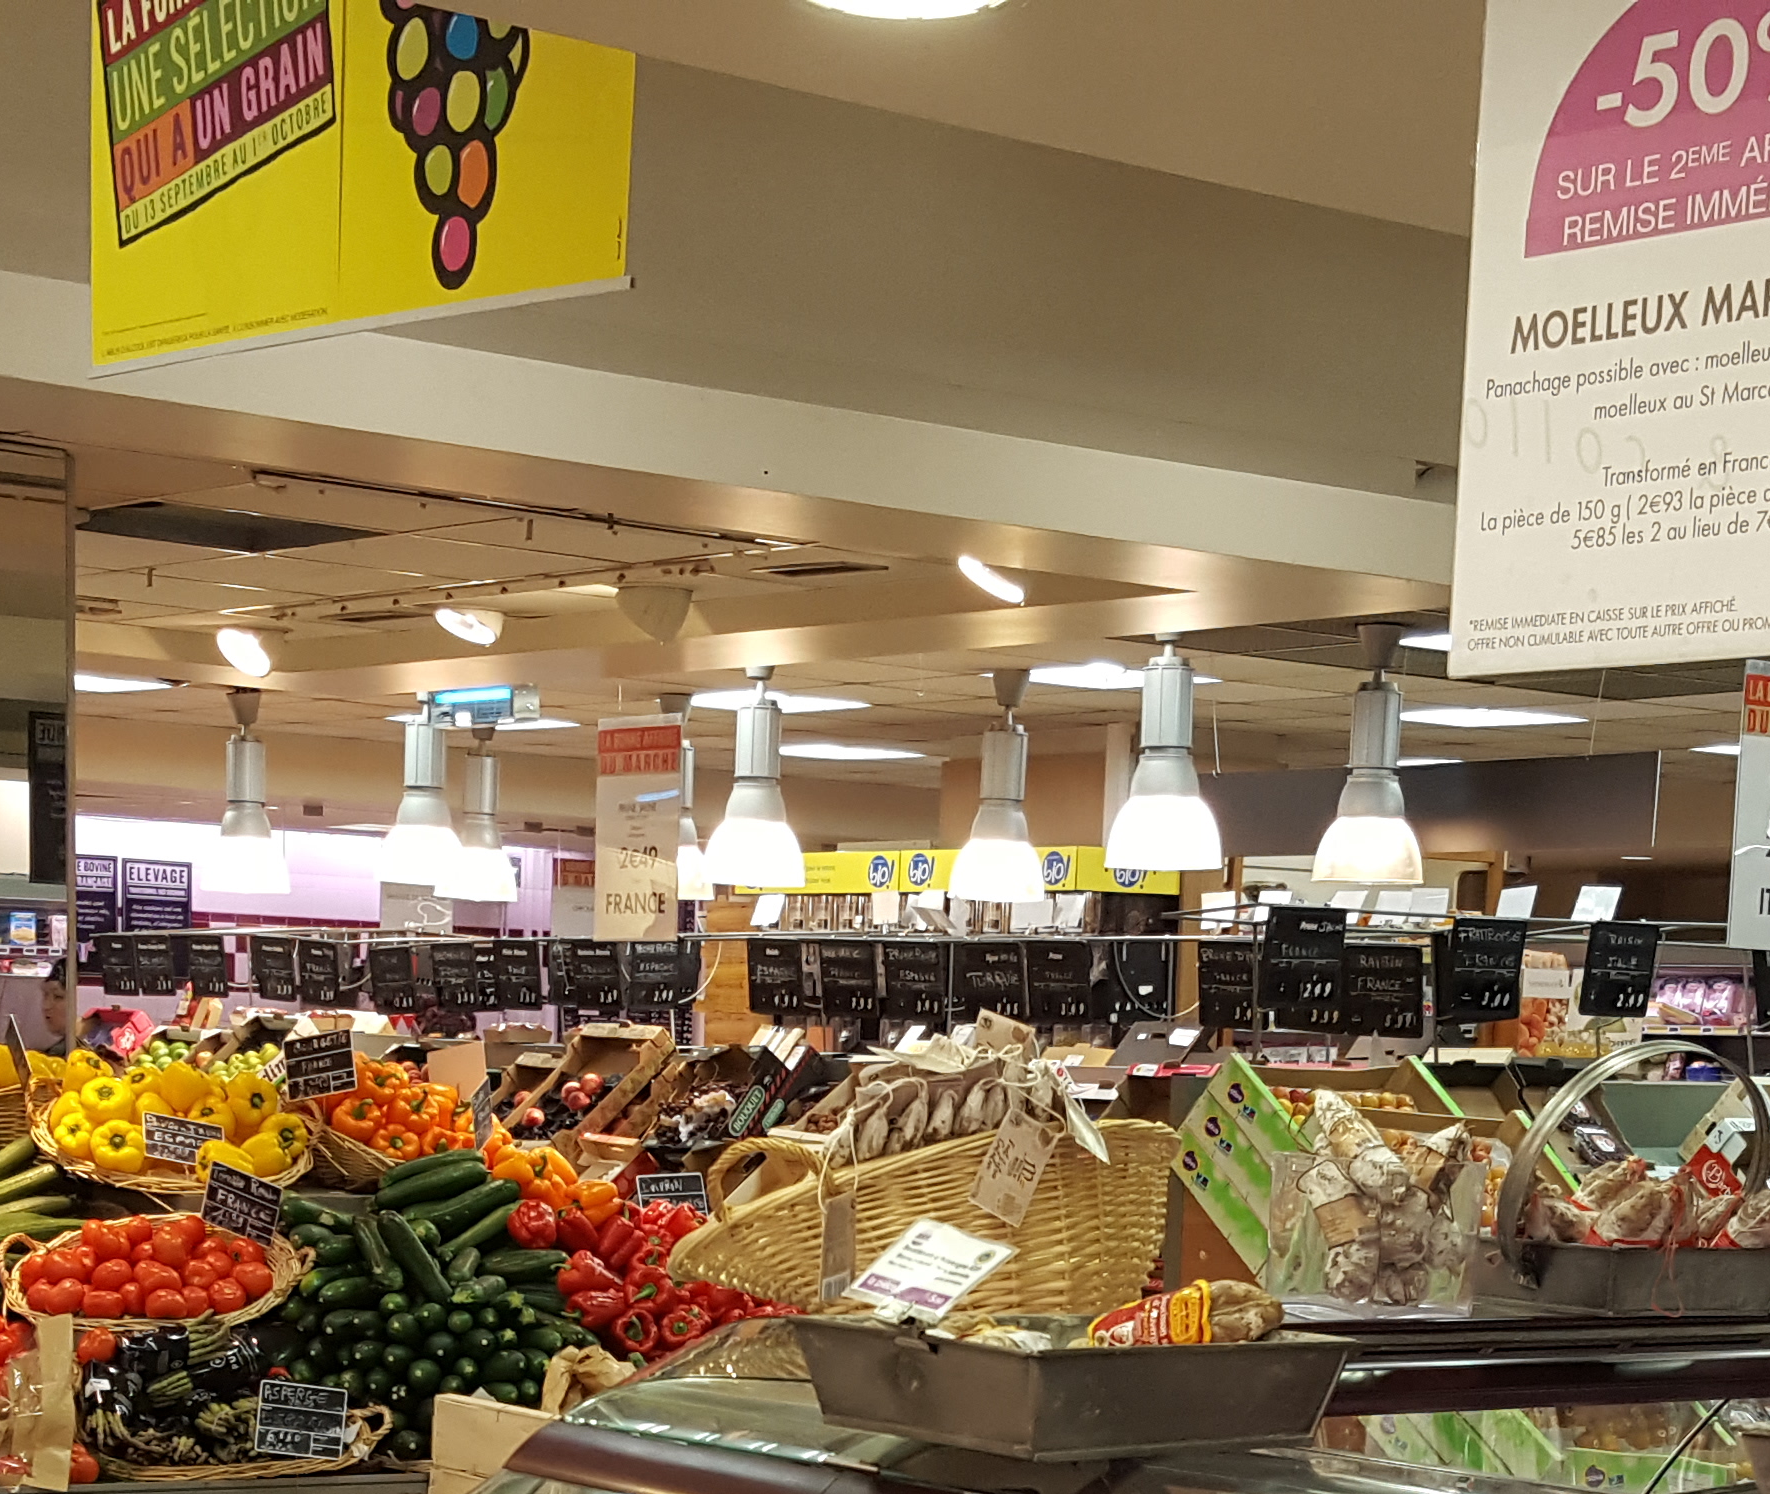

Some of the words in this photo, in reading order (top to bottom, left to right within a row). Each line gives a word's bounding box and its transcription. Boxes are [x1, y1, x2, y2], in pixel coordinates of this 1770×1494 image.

[107, 0, 136, 54] LA
[111, 42, 166, 130] UNE
[120, 128, 161, 204] QUI
[172, 113, 188, 167] A
[195, 83, 231, 150] UN
[241, 22, 325, 122] GRAIN
[124, 213, 140, 234] DU
[145, 199, 156, 223] 13
[160, 158, 228, 213] SEPTEMBRE
[232, 144, 247, 170] AU
[271, 92, 328, 146] OCTOBRE
[1556, 163, 1616, 200] SUR
[1624, 155, 1660, 188] LE
[1669, 141, 1730, 182] 2EME
[1562, 196, 1676, 247] REMISE
[1510, 291, 1689, 355] MOELLEUX
[1485, 370, 1572, 400] Panachage
[1575, 356, 1644, 395] possible
[1649, 357, 1690, 378] avec
[1593, 393, 1667, 420] moelleux
[1673, 393, 1694, 410] au
[1699, 384, 1716, 408] St
[1602, 458, 1691, 488] Transformé
[1697, 460, 1717, 477] en
[1502, 509, 1545, 536] pièce
[1550, 501, 1571, 524] de
[1577, 498, 1606, 522] 150
[1610, 502, 1622, 526] g
[1636, 489, 1684, 516] 2€93
[1688, 486, 1705, 510] la
[1709, 485, 1757, 514] pièce
[1570, 525, 1618, 550] 5€85
[1621, 522, 1644, 546] les
[1650, 521, 1661, 542] 2
[1666, 523, 1687, 541] au
[1692, 515, 1721, 538] lieu
[1726, 511, 1750, 535] de
[1467, 635, 1497, 651] OFFRE
[1498, 634, 1525, 649] NON
[1527, 629, 1584, 647] CUMULABLE
[1586, 627, 1613, 643] AVEC
[1615, 624, 1649, 640] TOUTE
[1650, 622, 1683, 638] AUTRE
[1686, 619, 1719, 636] OFFRE
[1721, 618, 1741, 633] OU
[1569, 611, 1585, 625] EN
[1587, 607, 1625, 623] CAISSE
[1627, 605, 1648, 620] SUR
[1650, 604, 1662, 619] LE
[1664, 603, 1687, 618] PRIX
[1748, 679, 1765, 702] LA
[1747, 708, 1770, 735] DU
[129, 866, 186, 885] ELEVAGE
[605, 892, 666, 915] FRANCE
